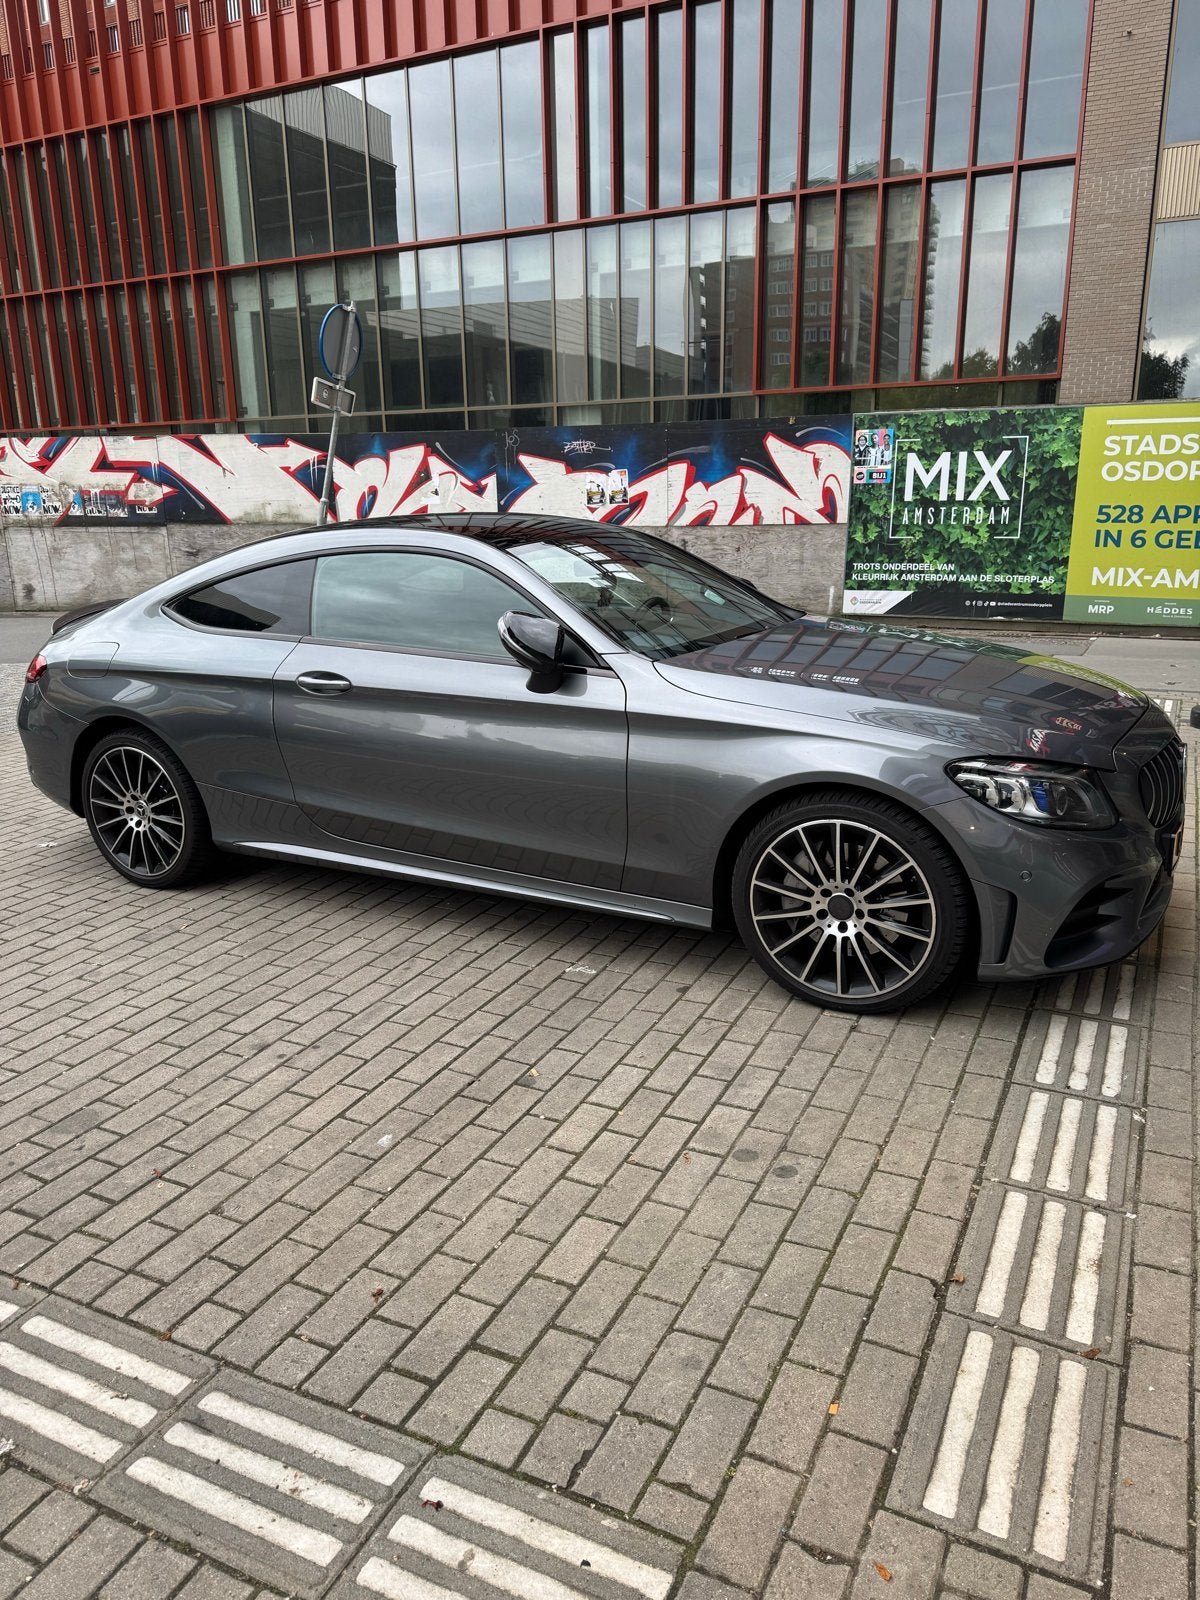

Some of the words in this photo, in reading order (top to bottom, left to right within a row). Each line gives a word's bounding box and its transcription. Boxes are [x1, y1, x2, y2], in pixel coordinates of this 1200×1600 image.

[904, 450, 1013, 501] MIX
[902, 506, 1010, 525] AMSTERDAM
[1096, 504, 1144, 524] 528
[1094, 529, 1123, 548] IN
[1130, 529, 1147, 549] 6
[852, 562, 881, 571] TROTS
[882, 562, 935, 571] ONDERDEEL
[937, 563, 955, 571] VAN
[852, 573, 899, 581] KLEURRIJK
[900, 573, 957, 582] AMSTERDAM
[958, 574, 978, 582] AAN
[980, 574, 992, 583] DE
[994, 575, 1055, 584] SLOTERPLAS
[1087, 604, 1115, 615] MRP
